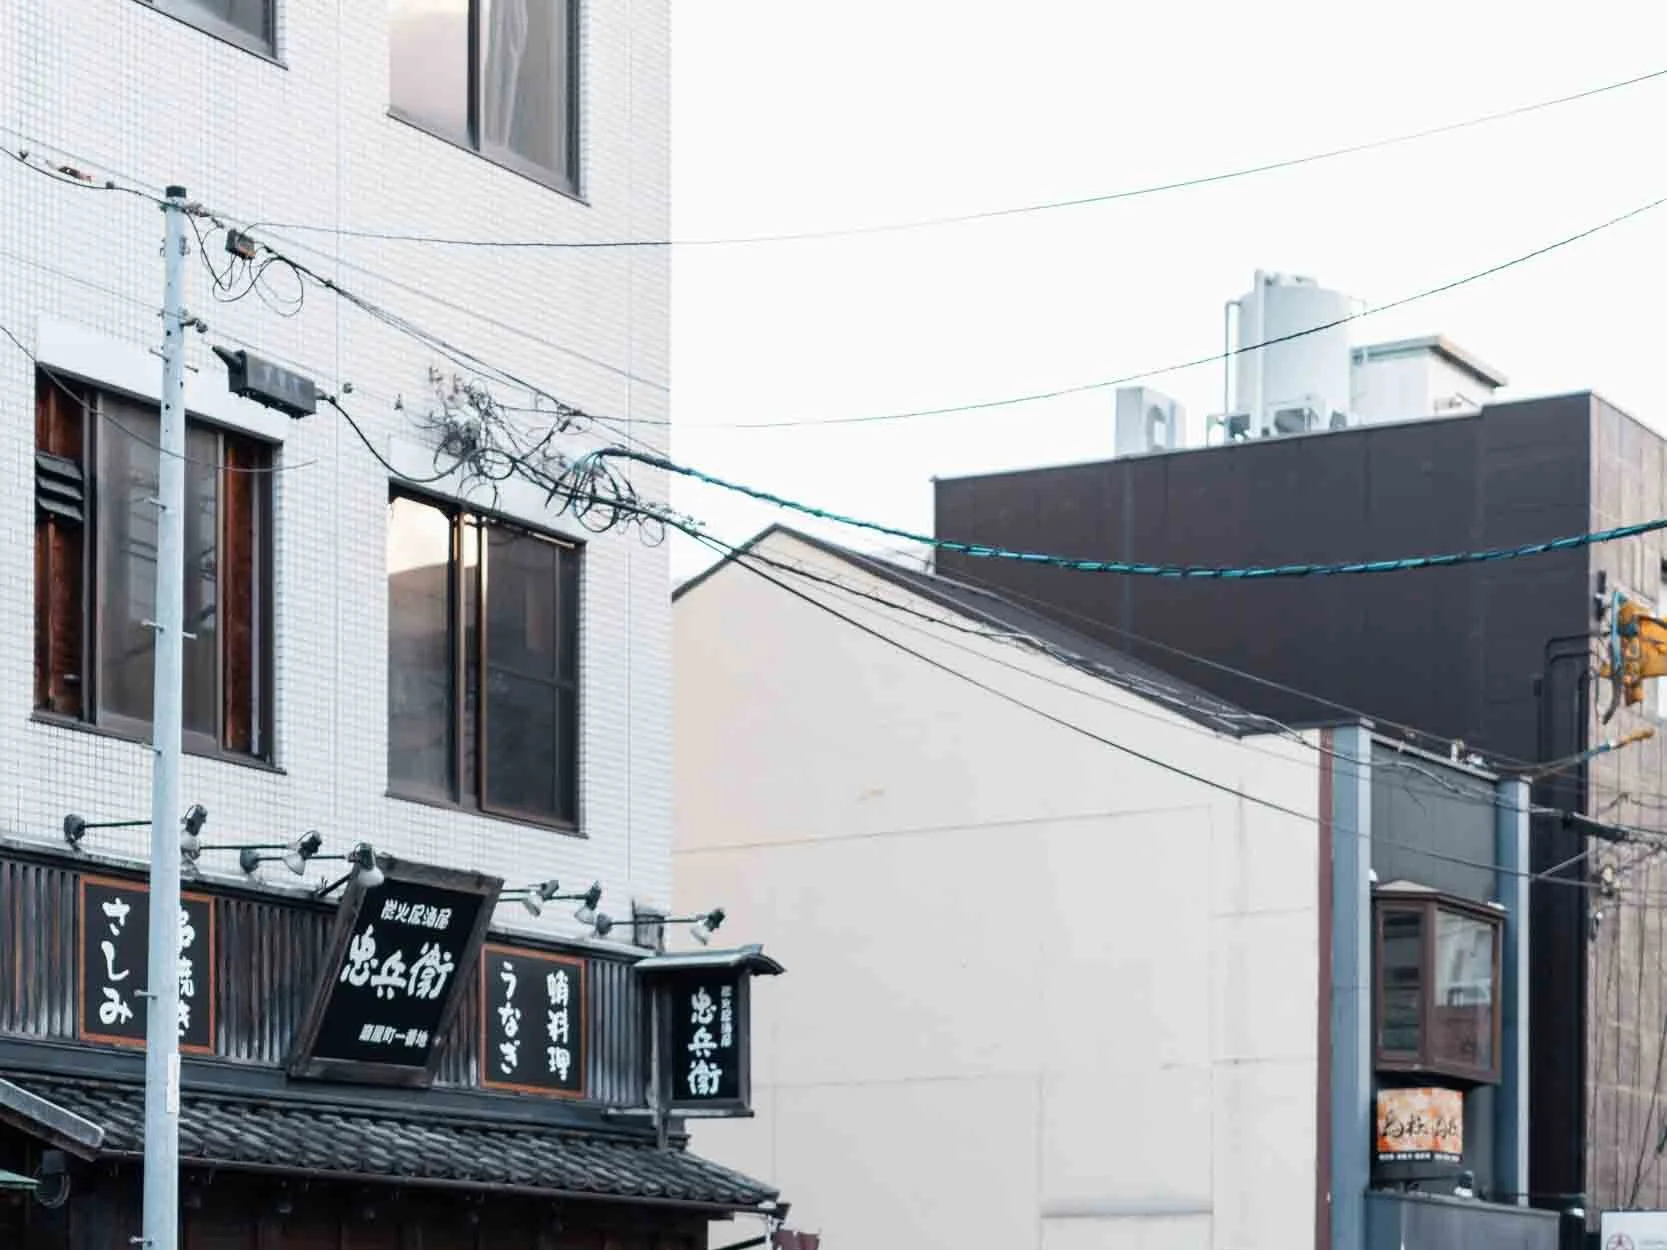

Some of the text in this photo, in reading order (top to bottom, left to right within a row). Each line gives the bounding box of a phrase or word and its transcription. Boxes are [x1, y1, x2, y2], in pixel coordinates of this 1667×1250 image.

[100, 897, 133, 1024] さしみ
[340, 924, 455, 999] 忠兵衛
[498, 961, 521, 1074] うなぎ
[687, 986, 722, 1095] 忠兵衛
